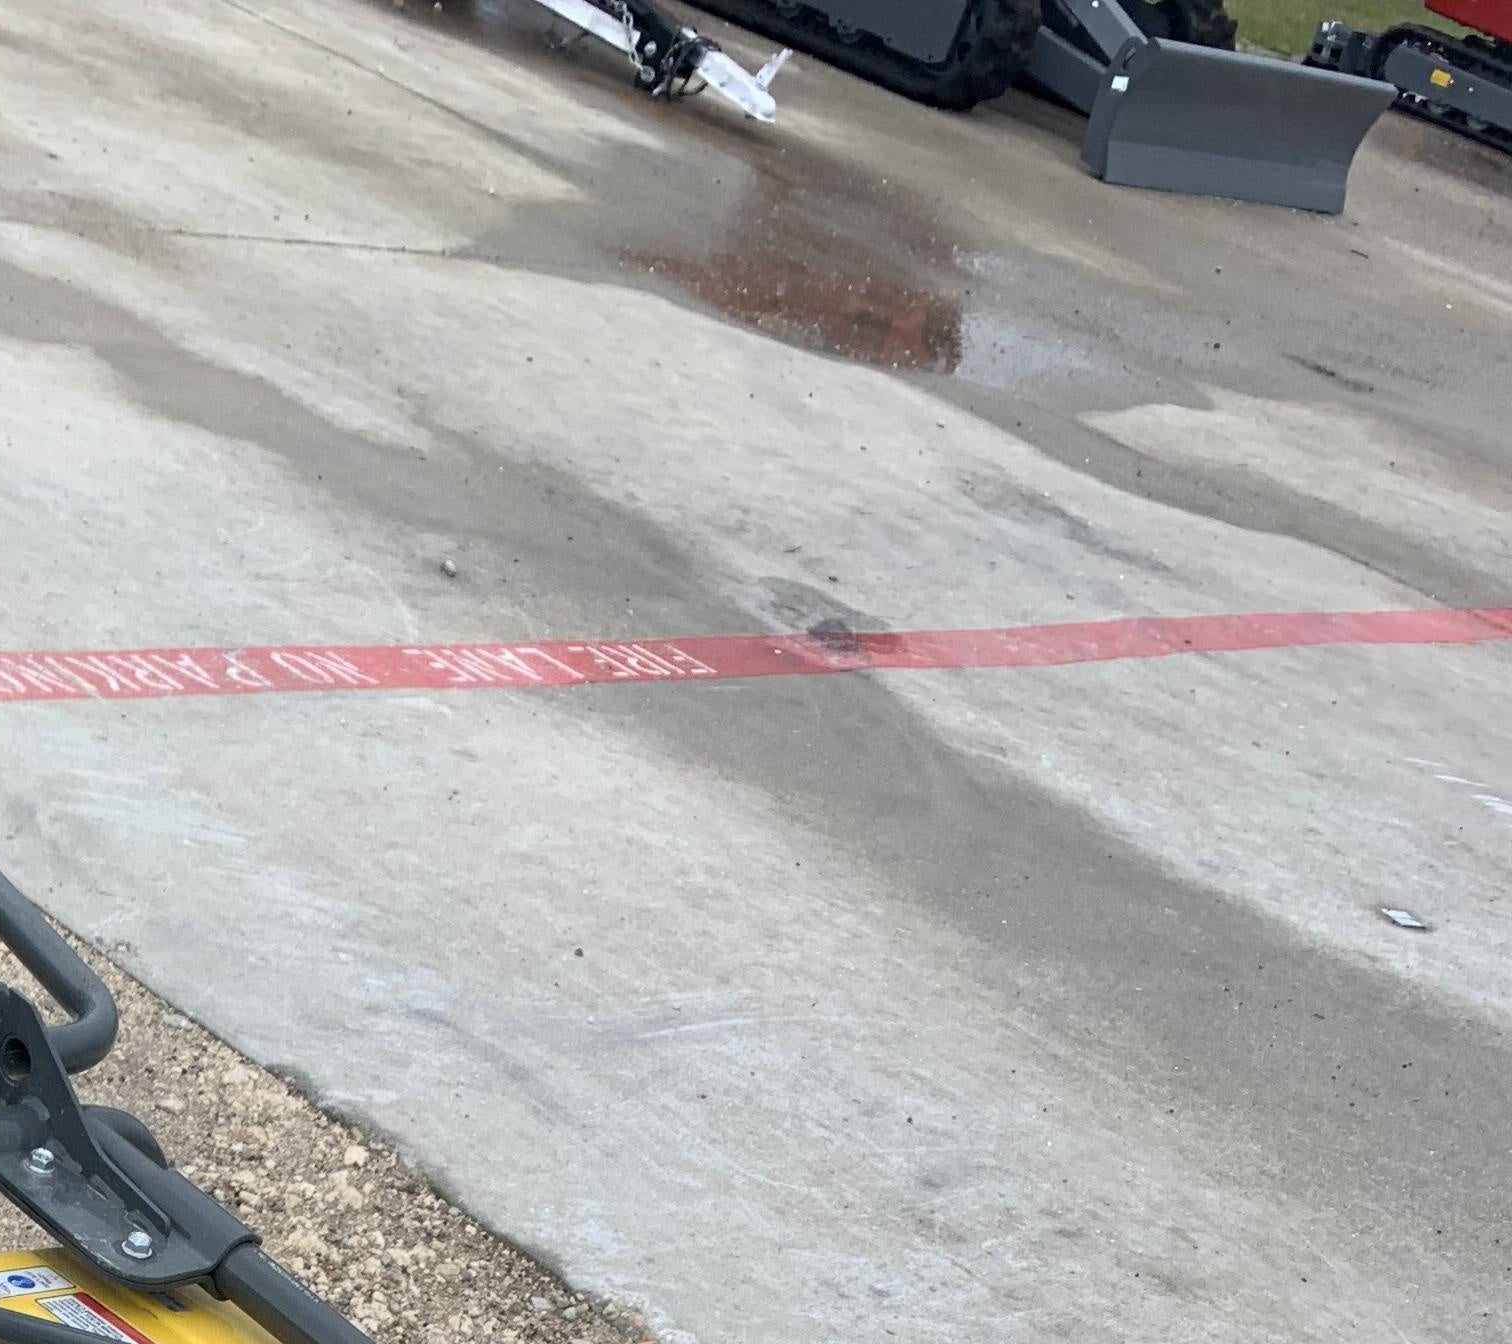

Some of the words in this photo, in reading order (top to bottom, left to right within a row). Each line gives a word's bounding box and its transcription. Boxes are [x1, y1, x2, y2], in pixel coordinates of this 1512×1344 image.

[271, 649, 374, 685] NO
[402, 644, 584, 684] LANE
[568, 638, 714, 678] FIRE
